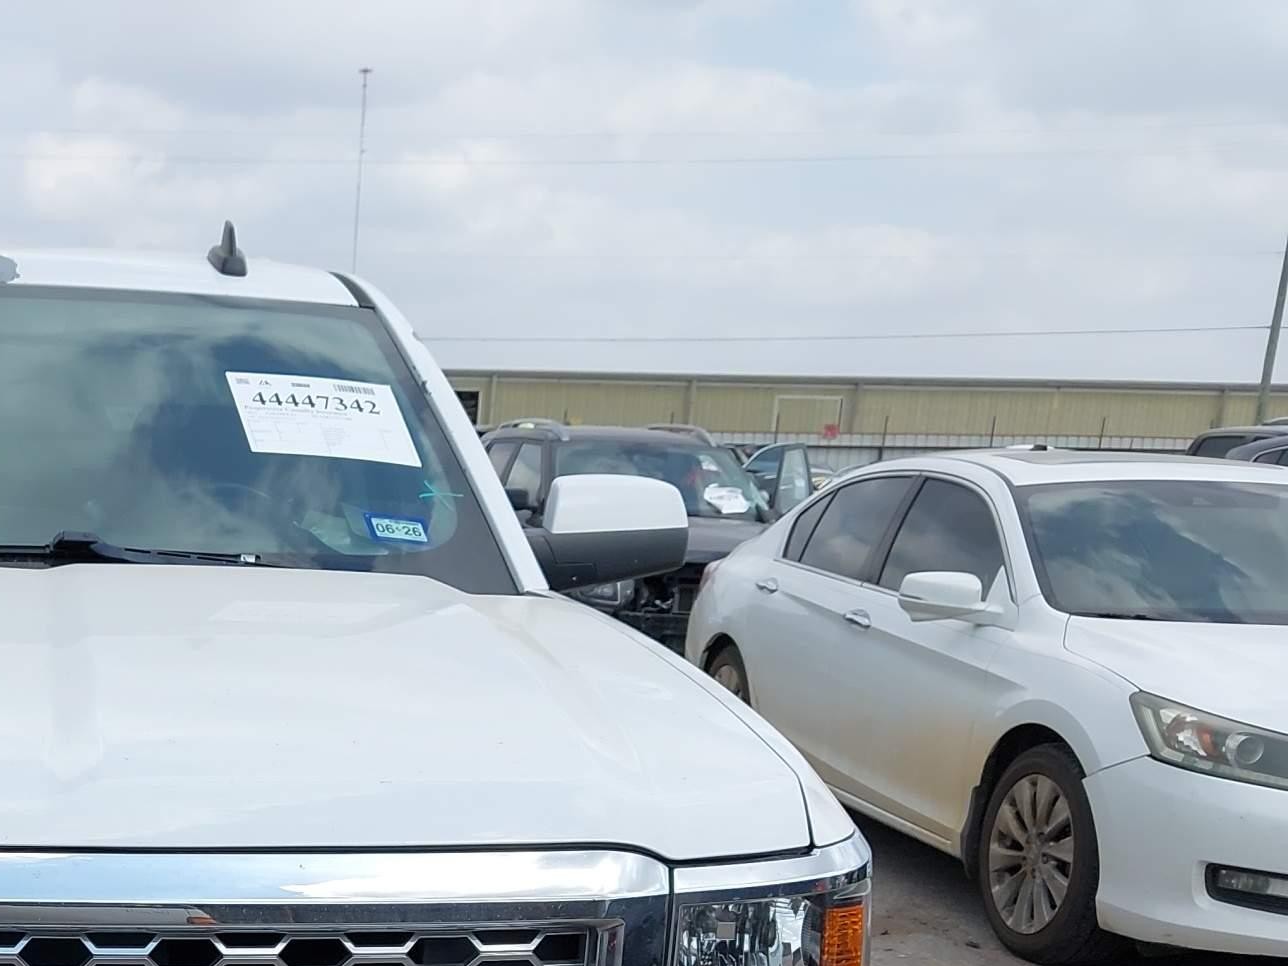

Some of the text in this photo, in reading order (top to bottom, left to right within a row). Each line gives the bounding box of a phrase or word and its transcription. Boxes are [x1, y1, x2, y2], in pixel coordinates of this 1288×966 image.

[252, 391, 381, 415] 44447342
[375, 523, 422, 537] 06 26
